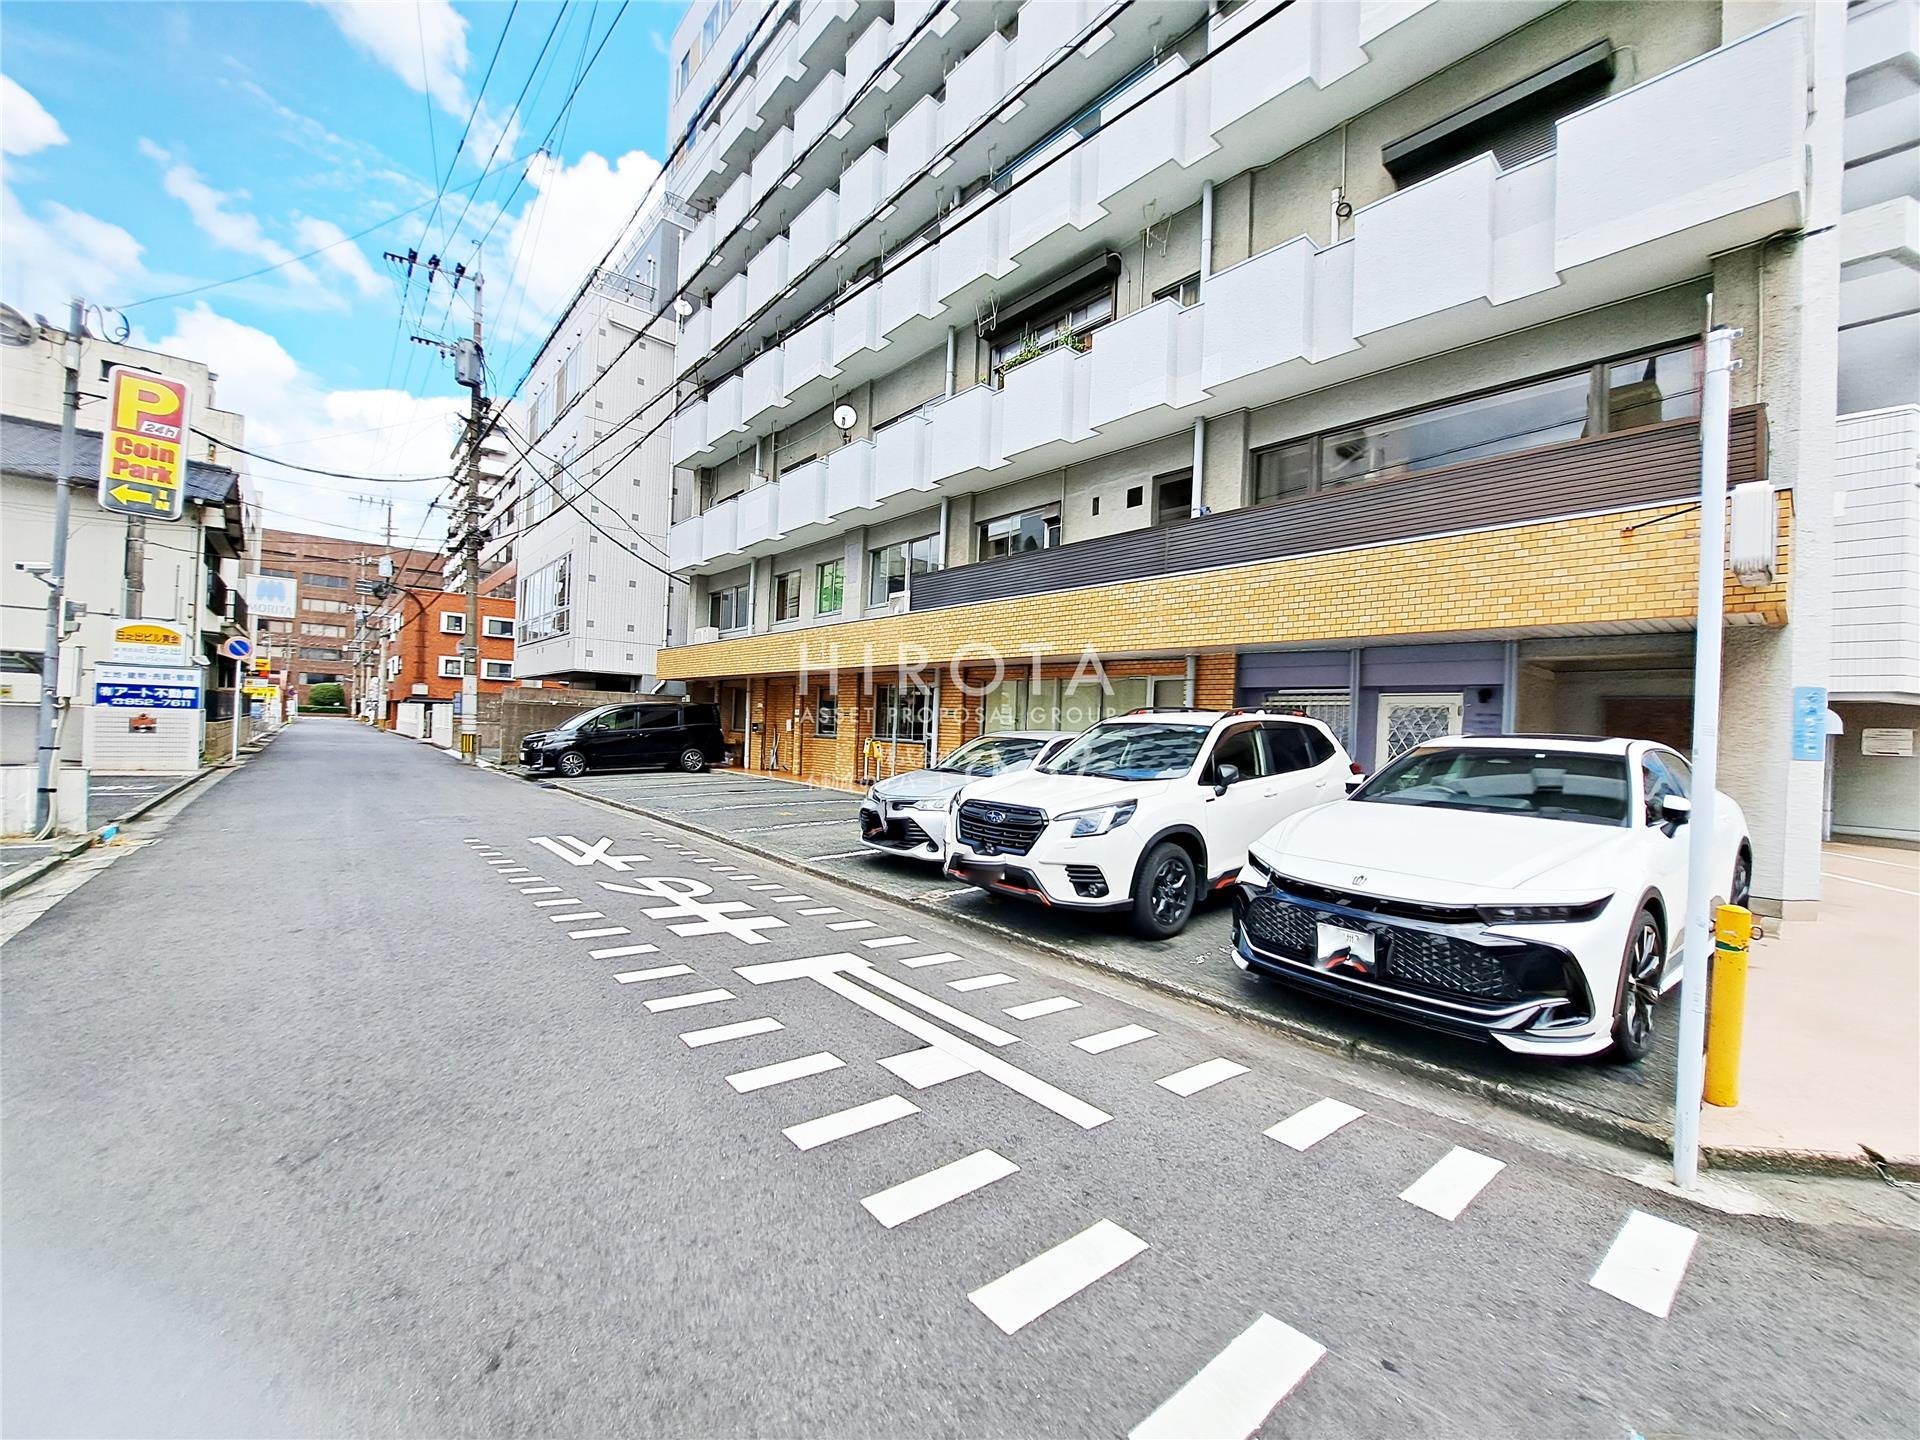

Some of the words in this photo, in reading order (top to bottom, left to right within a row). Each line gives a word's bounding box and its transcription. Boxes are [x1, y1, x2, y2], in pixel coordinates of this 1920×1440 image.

[116, 374, 180, 431] P
[144, 423, 176, 438] 24h
[114, 436, 175, 464] Coin
[112, 457, 173, 485] Park
